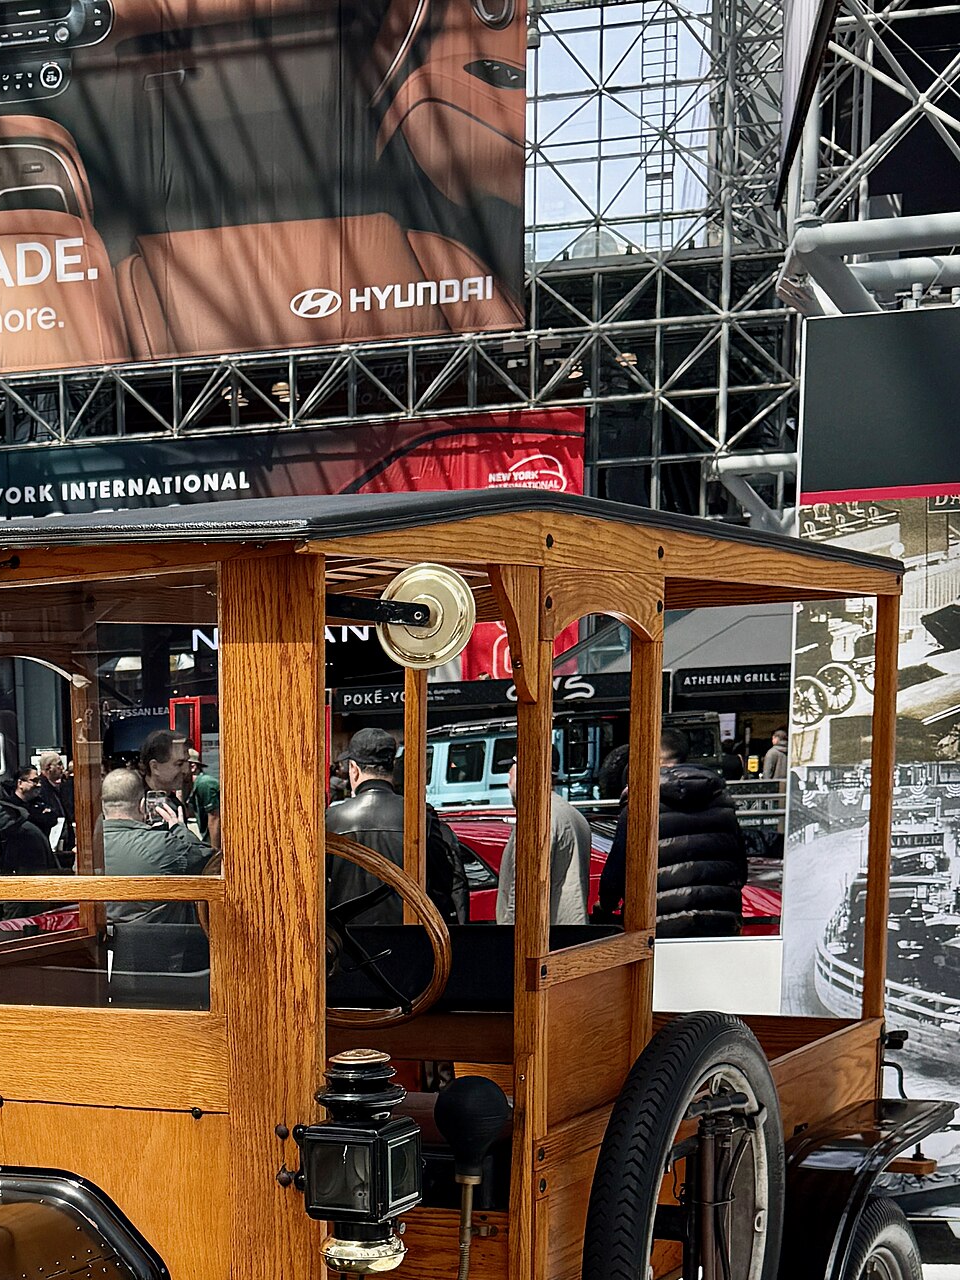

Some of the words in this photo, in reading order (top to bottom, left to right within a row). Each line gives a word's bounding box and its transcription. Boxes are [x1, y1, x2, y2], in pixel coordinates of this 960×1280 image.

[349, 276, 493, 312] HYUNDAI
[488, 472, 511, 482] NEW
[512, 470, 539, 480] YORK
[61, 471, 250, 501] INTERNATIONAL
[684, 674, 741, 686] ATHENIAN
[744, 672, 776, 683] GRILL
[343, 689, 406, 706] POKÉ-YO
[153, 707, 169, 716] LEA
